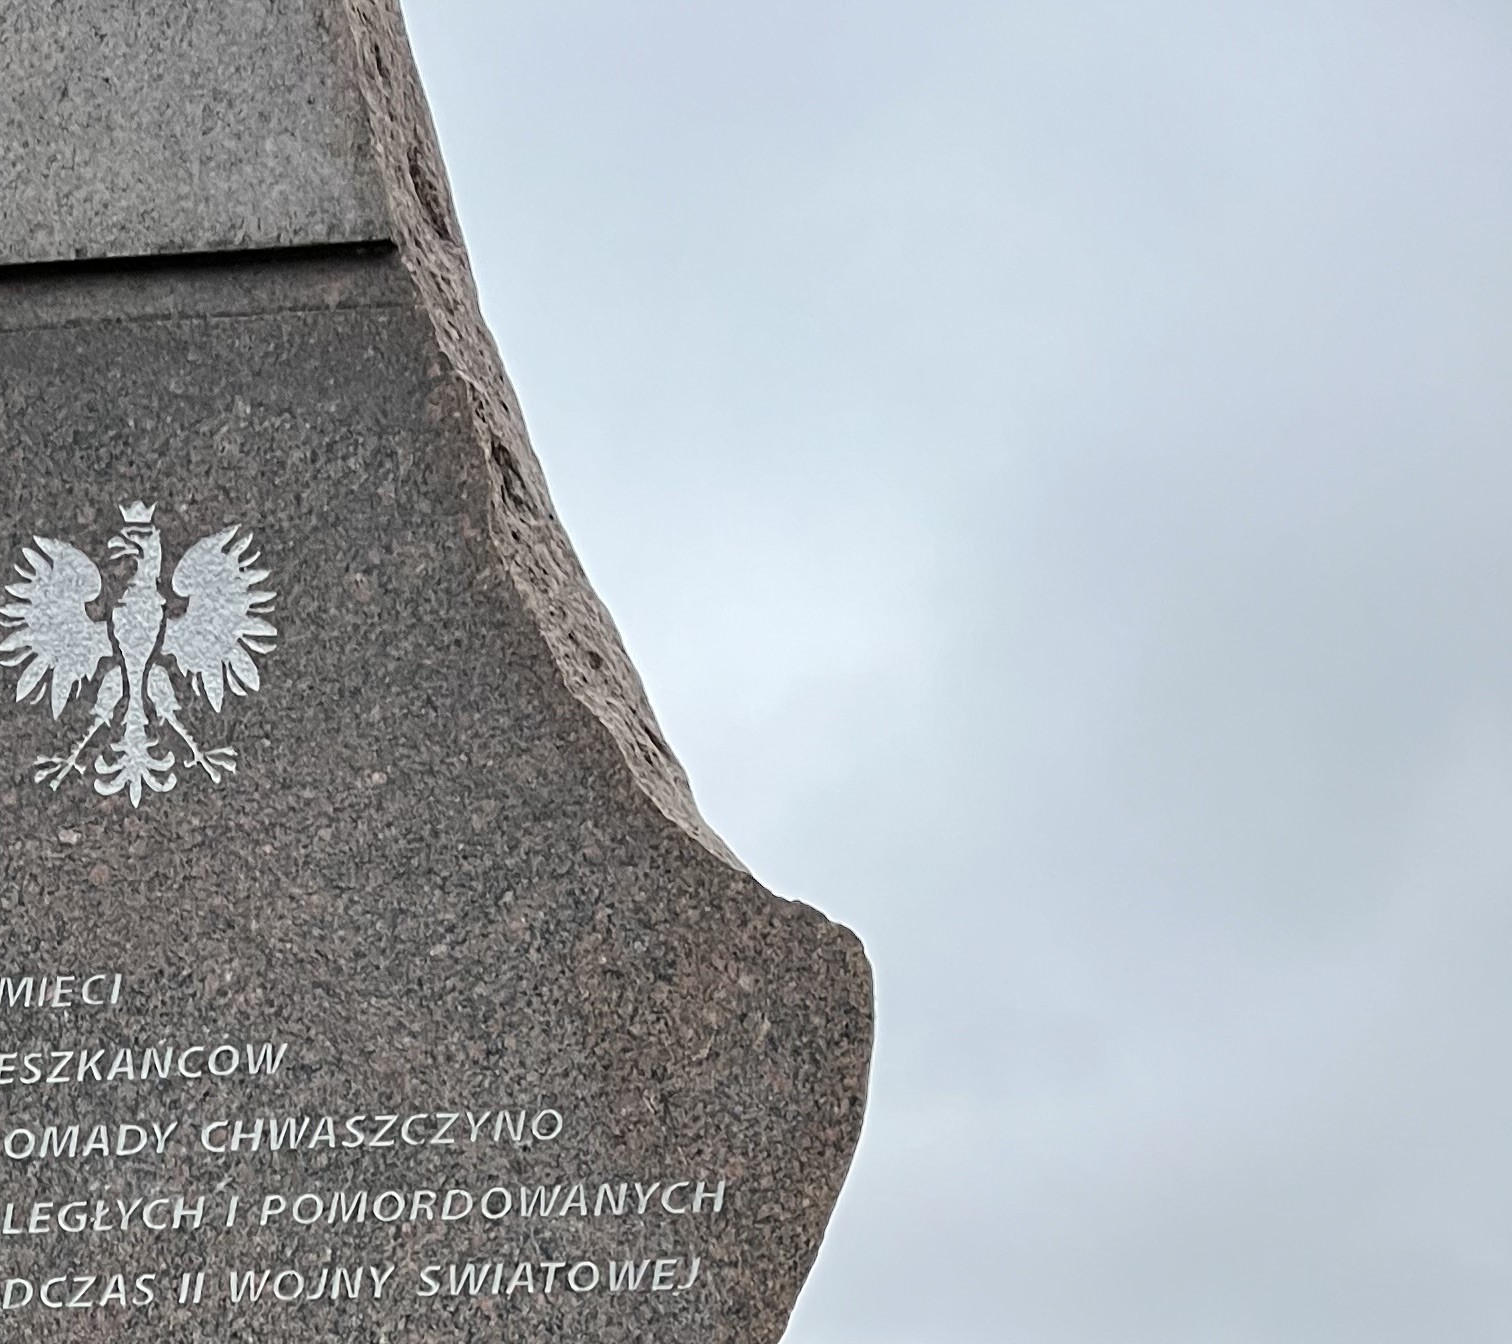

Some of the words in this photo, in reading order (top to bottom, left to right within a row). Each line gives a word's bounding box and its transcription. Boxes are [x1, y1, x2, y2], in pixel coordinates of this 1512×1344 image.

[201, 1108, 563, 1153] CHWASZCZYNO
[225, 1195, 240, 1228] I
[259, 1179, 726, 1226] POMORDOWANYCH
[178, 1271, 205, 1304] II
[229, 1264, 395, 1304] WOJNY
